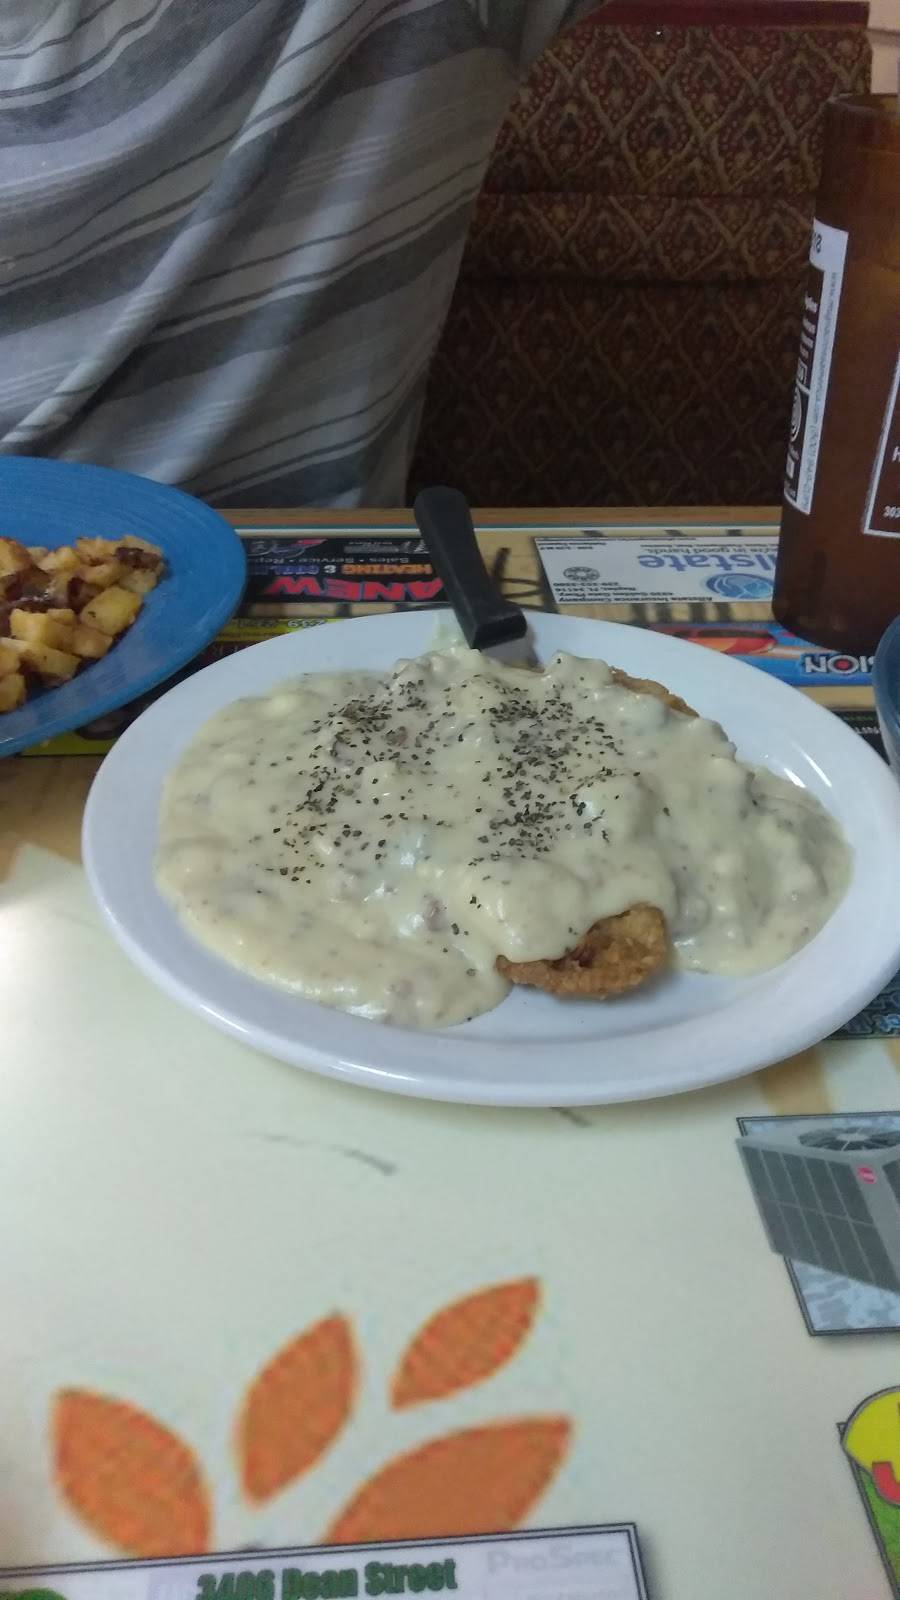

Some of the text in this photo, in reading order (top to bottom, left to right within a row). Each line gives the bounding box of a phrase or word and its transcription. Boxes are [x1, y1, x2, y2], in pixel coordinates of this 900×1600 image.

[324, 564, 337, 574] &
[341, 564, 433, 576] HEATING
[266, 577, 443, 601] ANEW
[281, 1566, 358, 1600] Dean
[364, 1558, 458, 1596] Street
